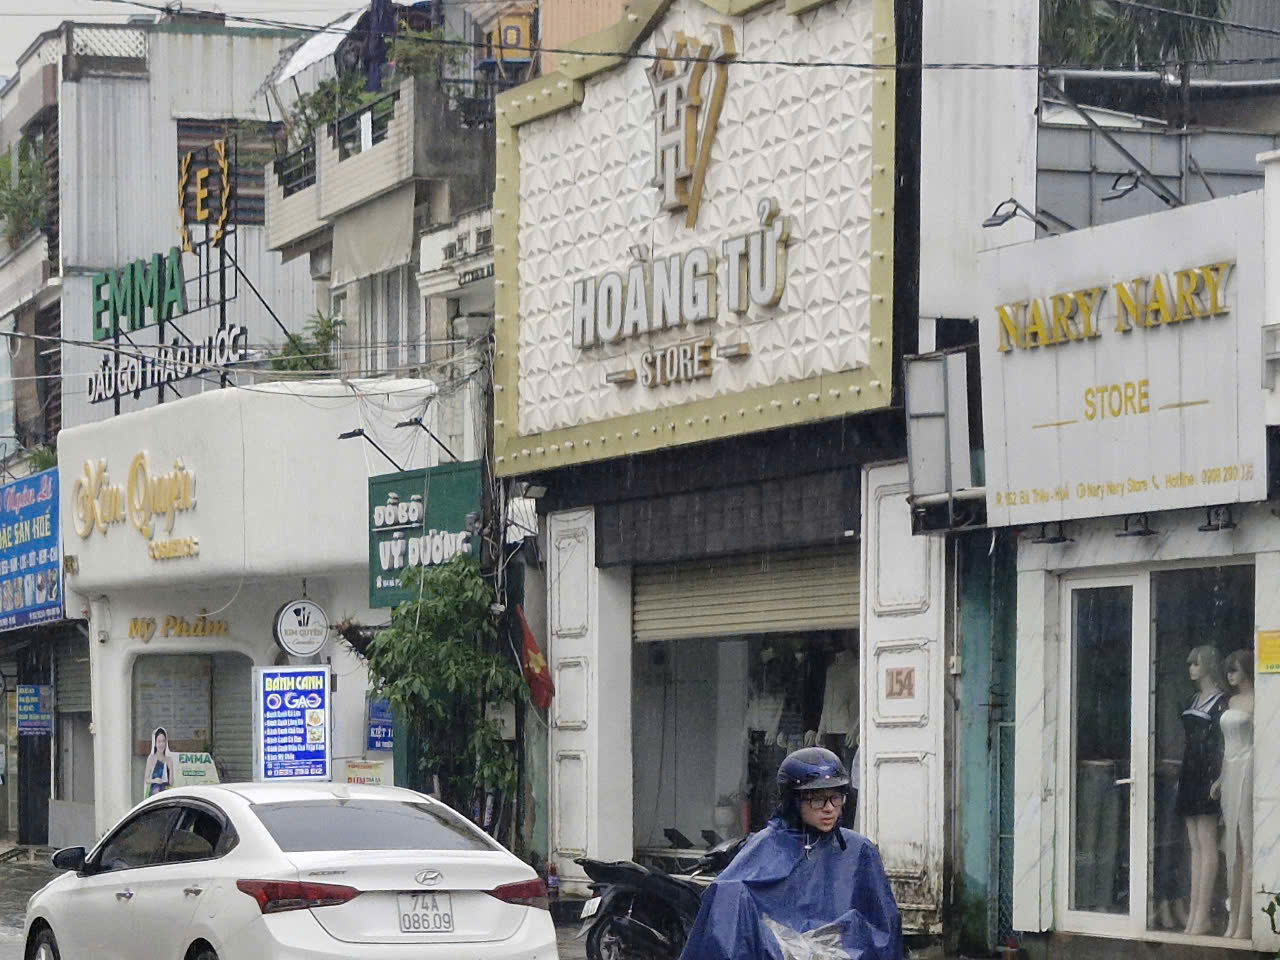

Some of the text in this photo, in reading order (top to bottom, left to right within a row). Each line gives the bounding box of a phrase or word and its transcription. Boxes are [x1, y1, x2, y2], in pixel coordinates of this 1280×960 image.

[92, 246, 188, 341] EMMA
[572, 197, 792, 349] HOÀNG TỬ
[995, 259, 1236, 354] NARY NARY
[641, 338, 713, 389] STORE
[1084, 379, 1150, 421] STORE
[72, 458, 126, 538] Kim
[128, 449, 196, 540] Quyên
[296, 675, 324, 690] CANH
[887, 670, 914, 697] 154
[179, 753, 211, 764] EMMA
[402, 913, 451, 930] 086.09
[411, 893, 439, 911] 74A
